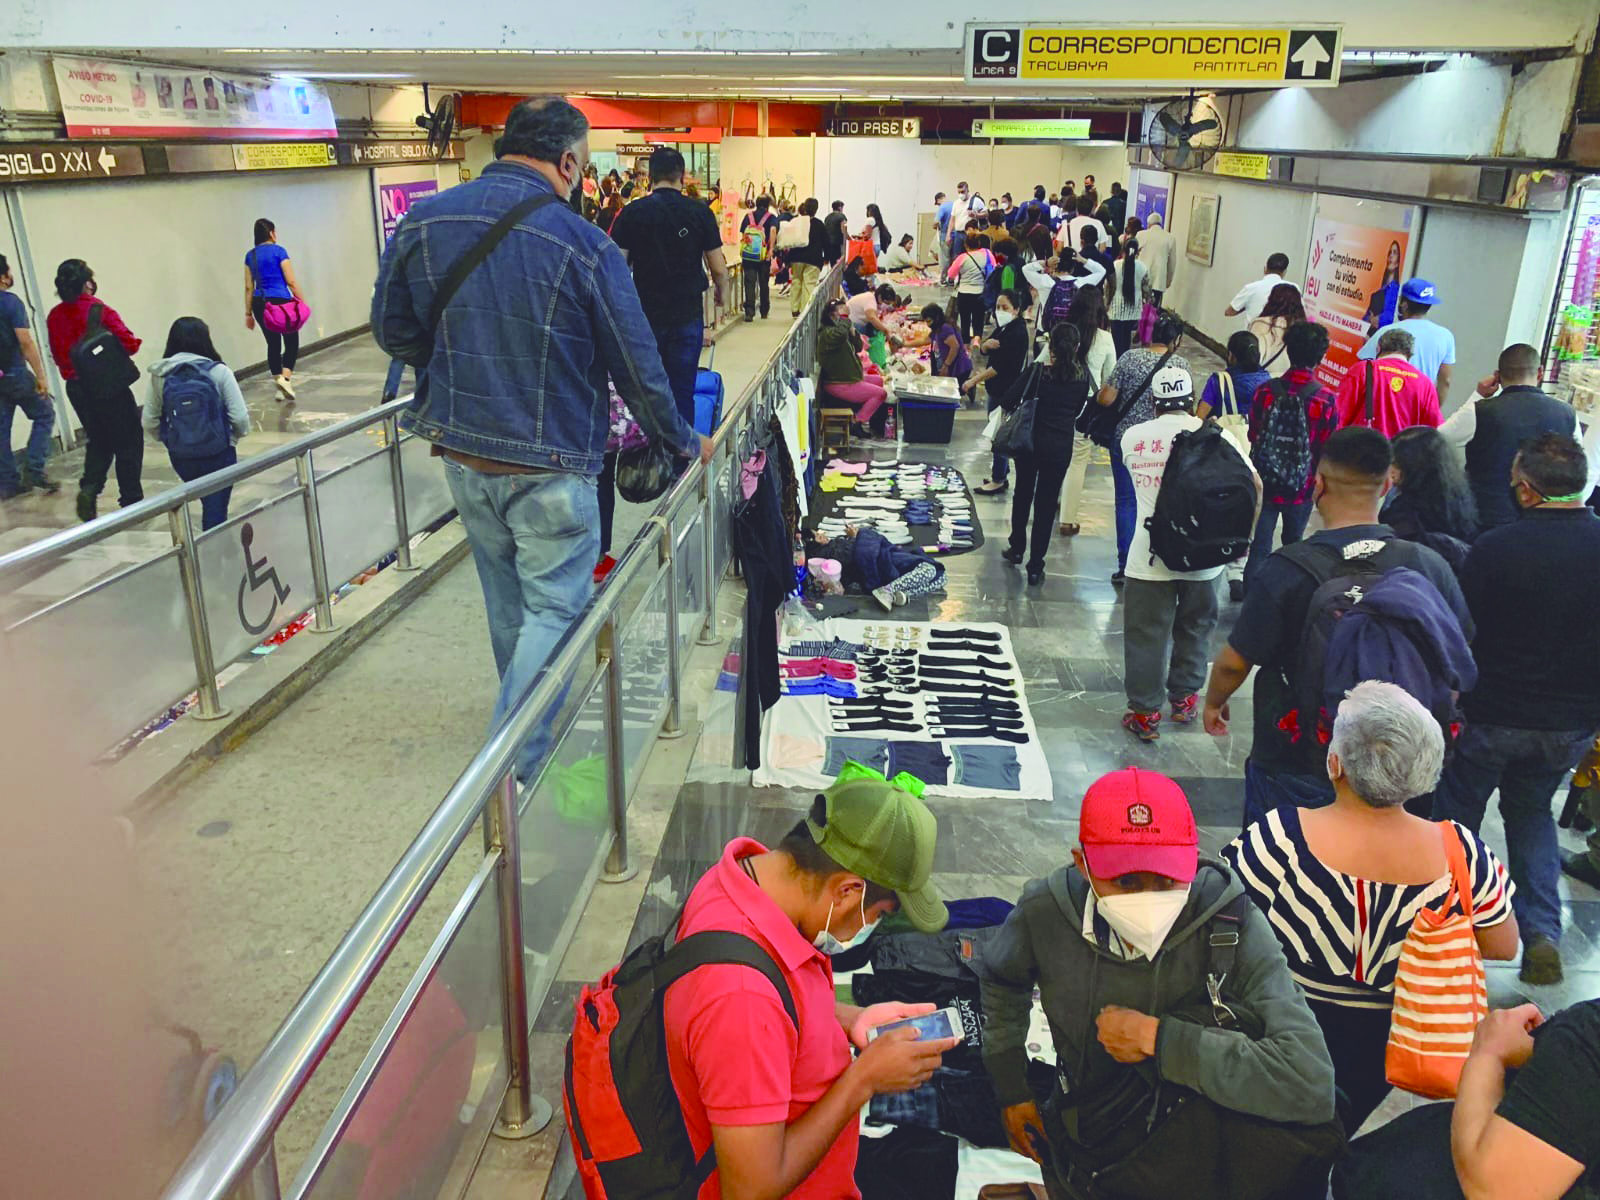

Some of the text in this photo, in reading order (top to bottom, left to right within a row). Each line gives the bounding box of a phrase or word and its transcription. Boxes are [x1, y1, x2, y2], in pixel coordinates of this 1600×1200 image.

[982, 31, 1011, 62] C
[1028, 36, 1281, 54] CORRESPONDENCIA
[974, 67, 1016, 75] LINEA 9
[1027, 60, 1108, 72] TACUBAYA
[1193, 61, 1277, 72] PANTITLAN
[68, 70, 117, 82] AVISO METRO
[80, 94, 112, 103] COVID-19
[841, 122, 899, 134] NO PASE
[248, 145, 325, 158] CORRESPONDENCIA
[364, 145, 399, 159] HOSPITAL
[401, 144, 420, 158] SIGLO
[0, 151, 92, 175] SIGLO XXI
[381, 188, 406, 220] NO
[1329, 249, 1374, 272] Complementa
[1335, 269, 1357, 285] tu vida
[1326, 282, 1336, 292] con
[1341, 317, 1362, 331] MANERA
[1160, 380, 1184, 393] TMT
